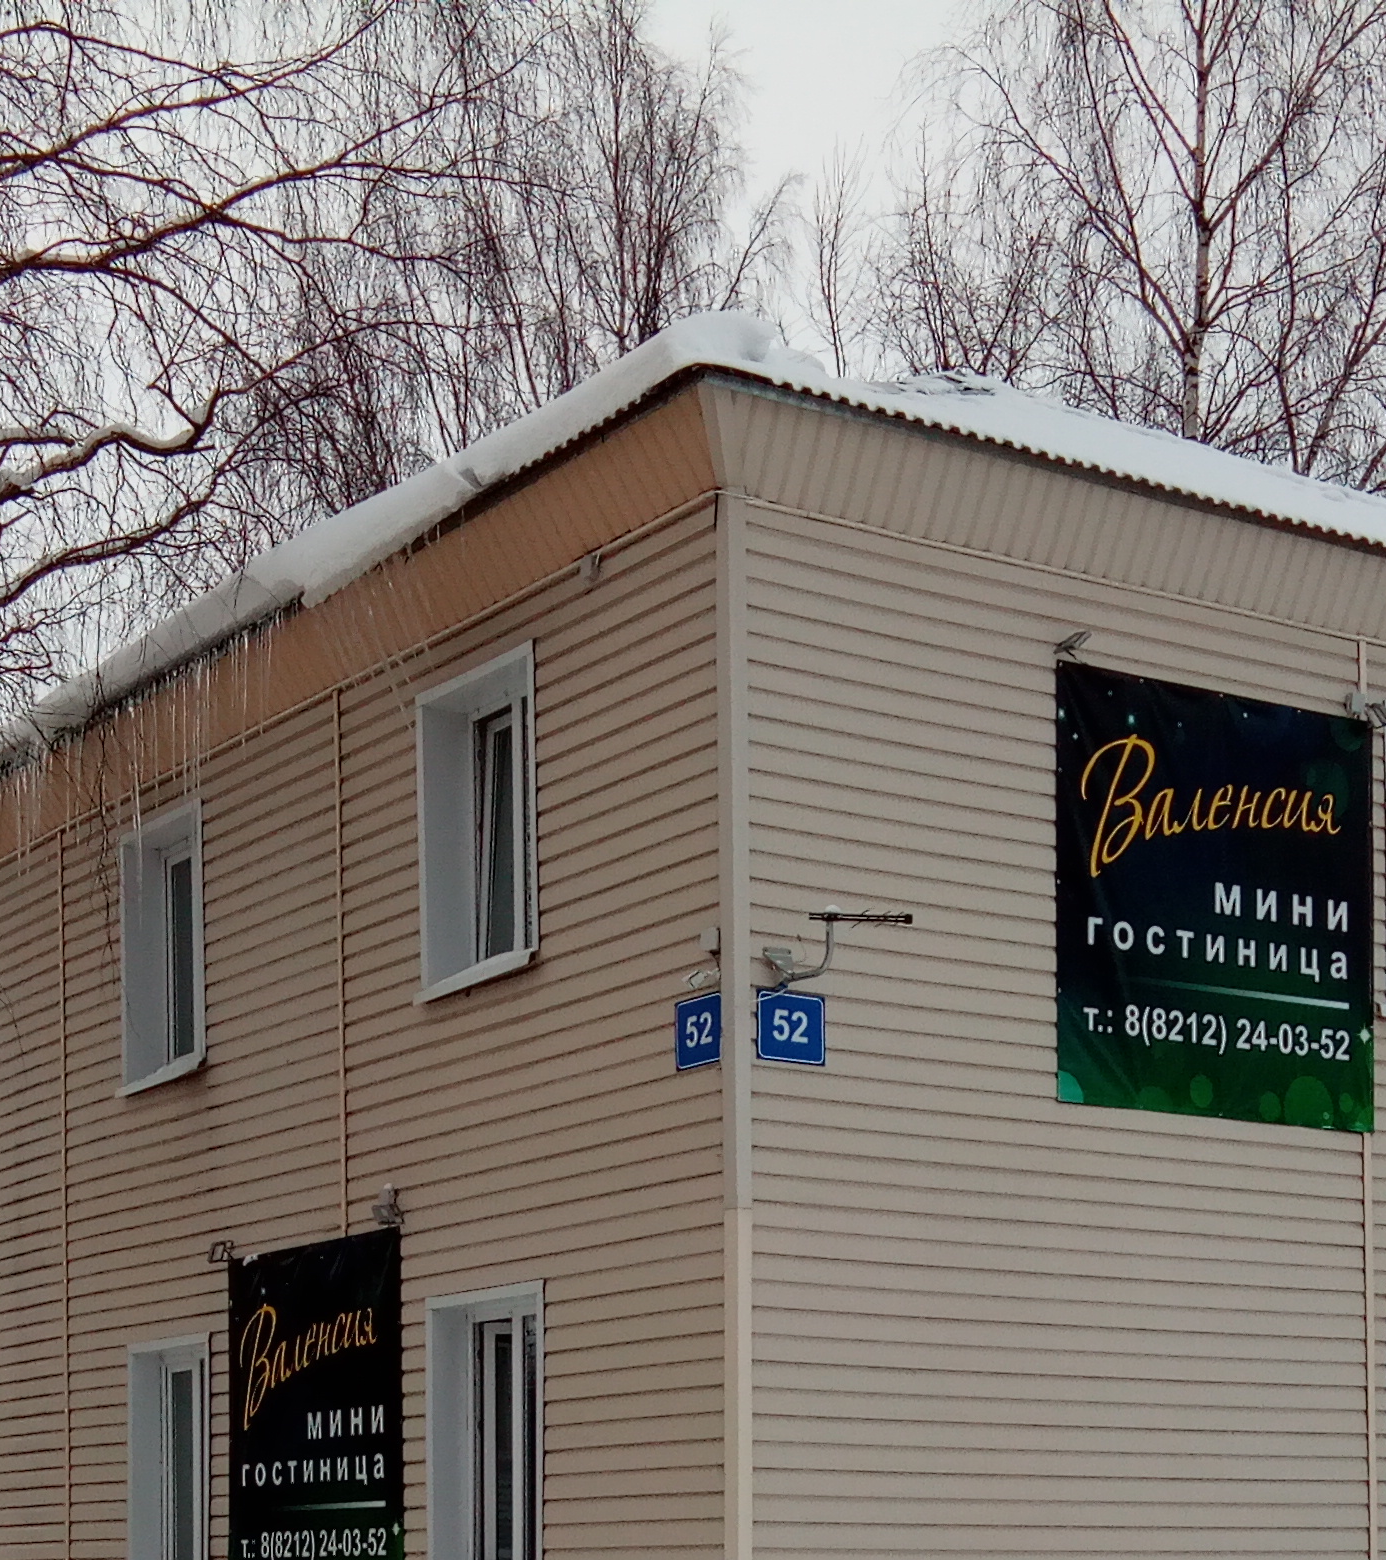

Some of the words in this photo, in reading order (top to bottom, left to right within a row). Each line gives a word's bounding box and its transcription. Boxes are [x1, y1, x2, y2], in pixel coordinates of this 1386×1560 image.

[1080, 733, 1341, 877] Валенсия
[1086, 916, 1349, 982] гостиница
[685, 1011, 713, 1048] 52
[772, 1008, 809, 1044] 52
[1124, 1004, 1227, 1055] 8(8212)
[1235, 1018, 1351, 1062] 24-03-52
[239, 1304, 377, 1431] Валенсия
[241, 1452, 385, 1487] гостиница
[319, 1527, 387, 1557] 24-03-52
